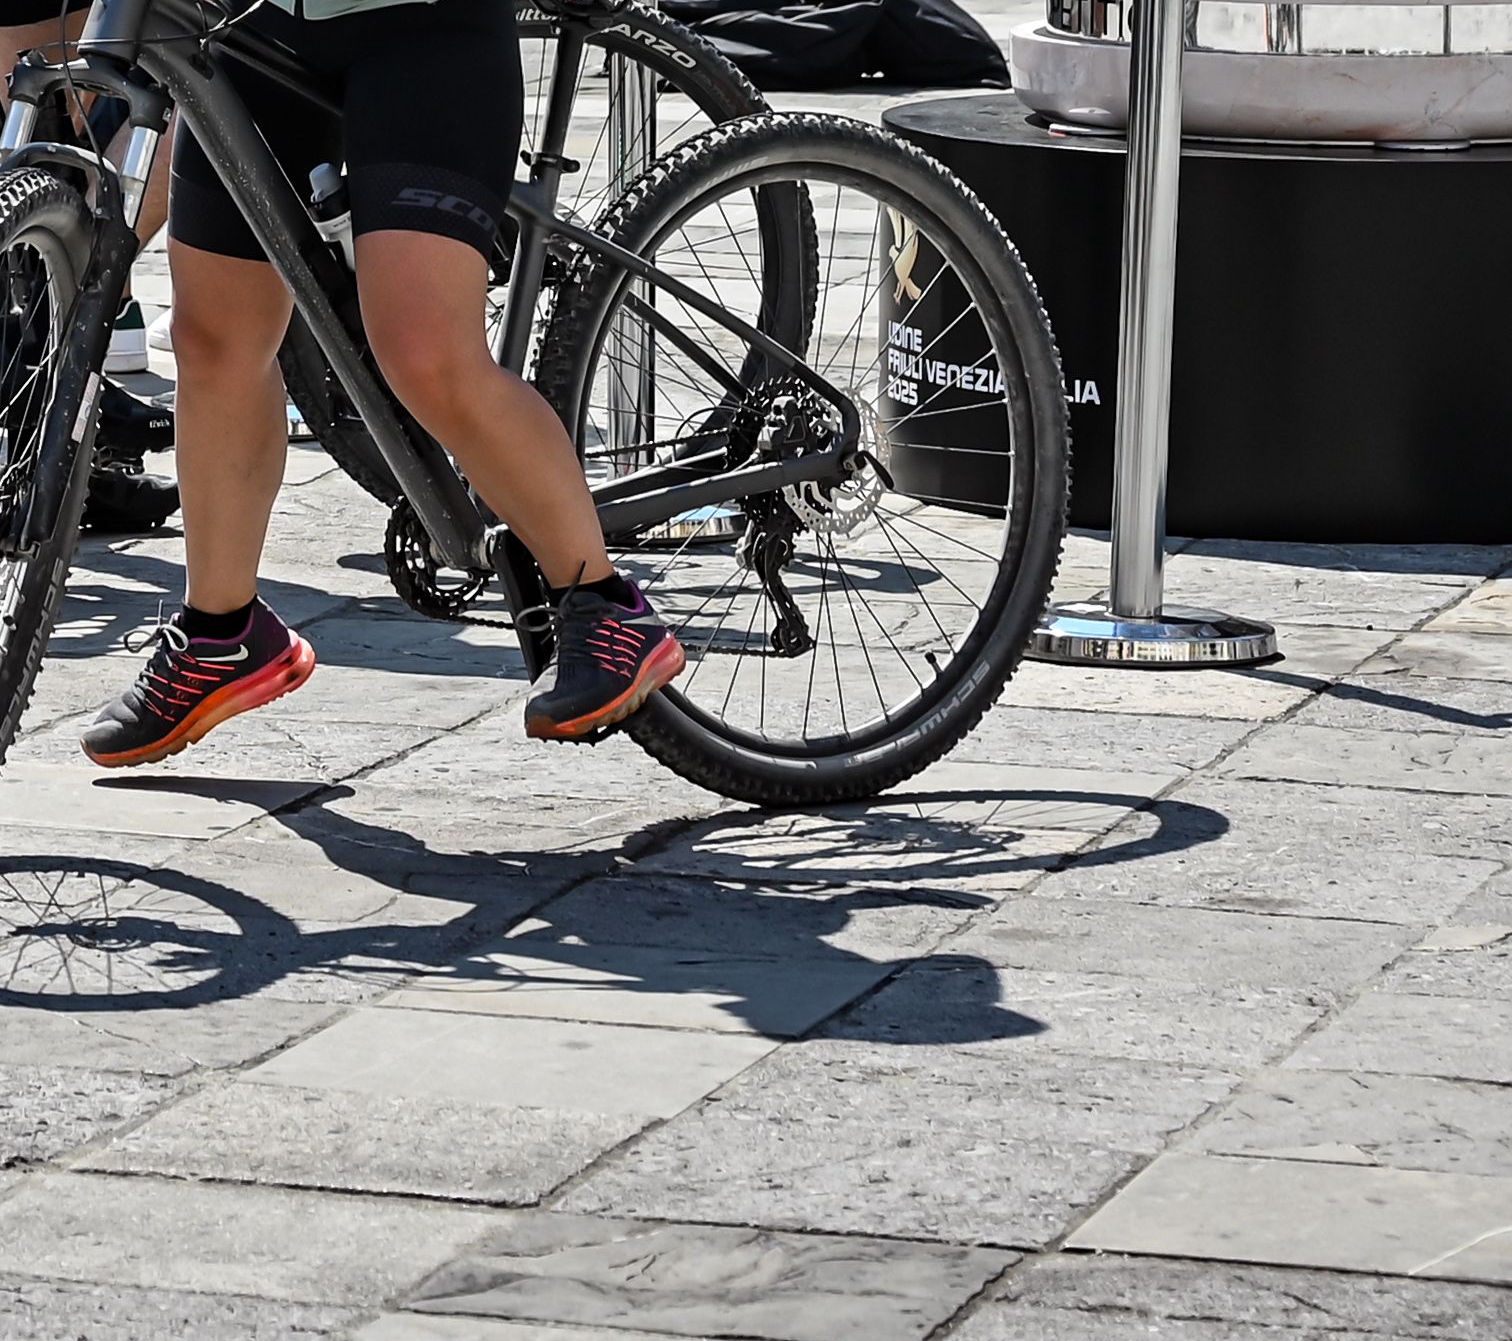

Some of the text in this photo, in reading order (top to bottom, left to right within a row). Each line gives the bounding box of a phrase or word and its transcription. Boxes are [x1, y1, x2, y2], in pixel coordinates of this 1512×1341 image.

[608, 23, 697, 69] ARZO
[391, 186, 495, 231] SCO
[887, 347, 923, 381] FRIULI
[887, 374, 919, 406] 2025
